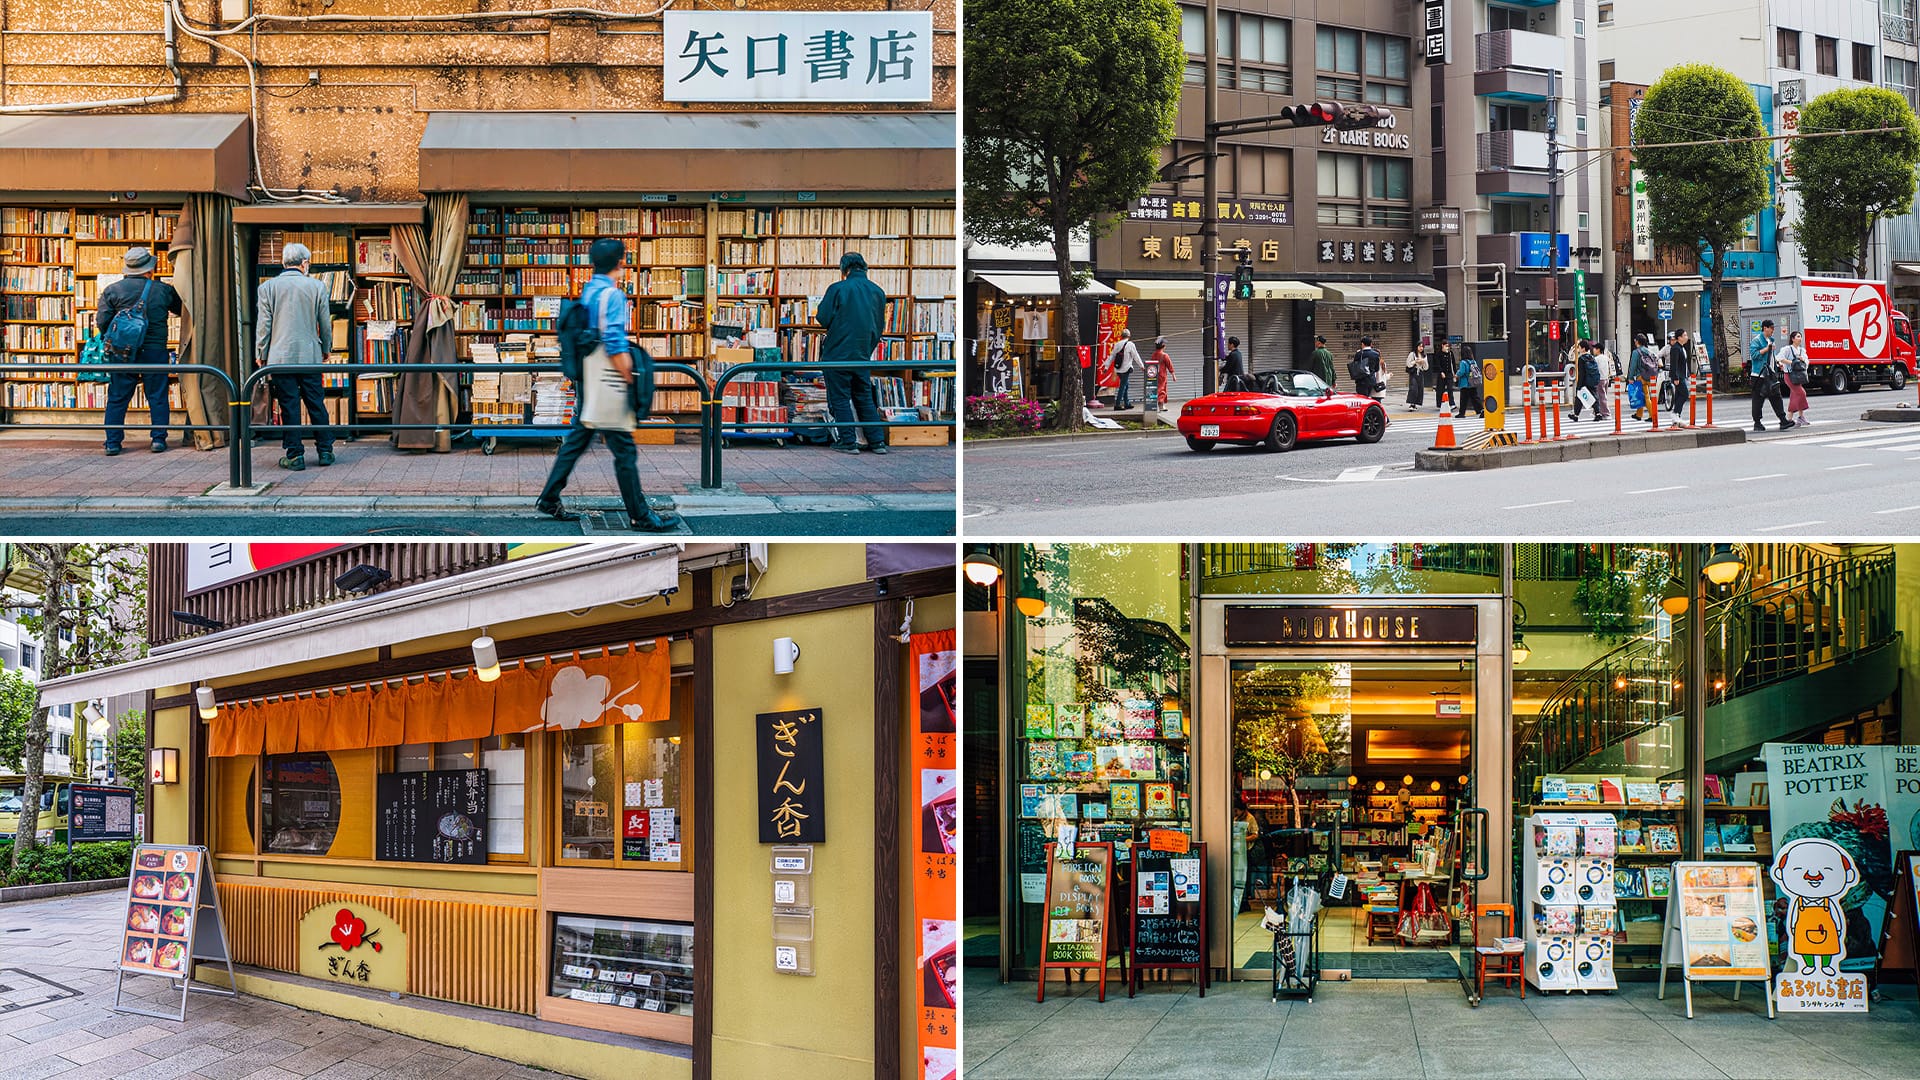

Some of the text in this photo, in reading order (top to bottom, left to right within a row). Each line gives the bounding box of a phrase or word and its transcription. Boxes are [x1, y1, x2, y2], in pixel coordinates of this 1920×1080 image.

[679, 30, 917, 84] 矢口書店
[1340, 130, 1370, 146] RARE
[1374, 133, 1409, 149] BOOKS
[1172, 201, 1246, 220] 古書買入
[1142, 235, 1280, 262] 東陽書店
[1813, 293, 1840, 302] ビックカメラ
[1820, 304, 1834, 312] コジマ
[1815, 315, 1840, 323] ソフマップ
[1283, 611, 1419, 638] BOOKHOUSE
[924, 747, 947, 758] 弁当
[1781, 745, 1804, 755] THE
[1782, 752, 1867, 775] BEATRIX
[771, 714, 816, 838] ぎん香
[1075, 850, 1090, 859] 2F
[925, 868, 947, 879] 弁当
[1062, 862, 1102, 873] FOREIGN
[1053, 950, 1073, 960] BOOK
[328, 956, 371, 981] ぎん香
[1780, 977, 1863, 1000] あるかしら書店
[925, 1022, 949, 1035] 弁当
